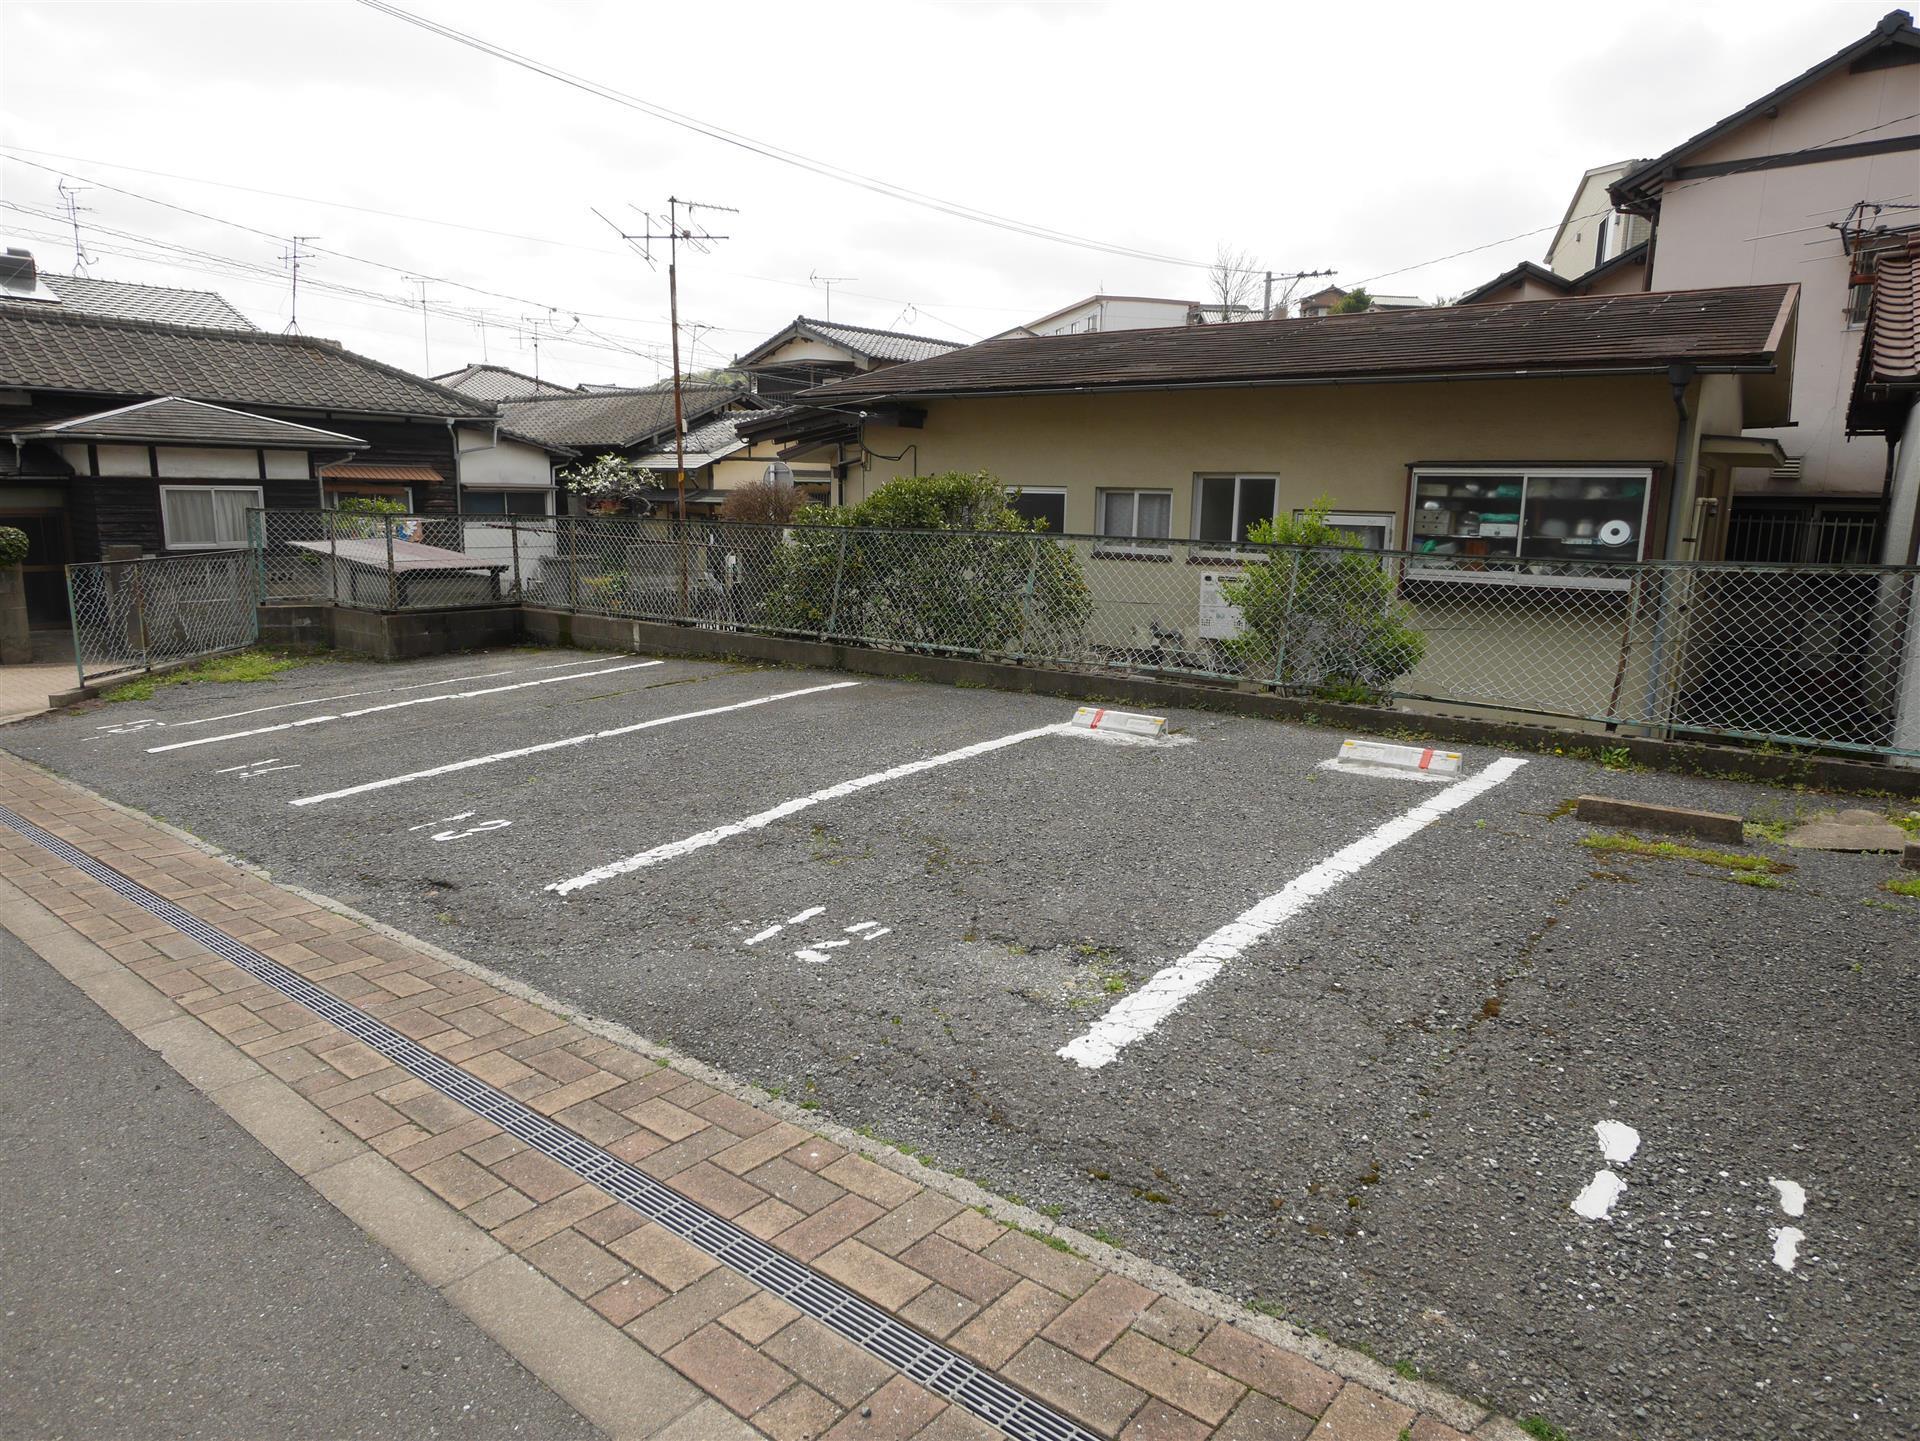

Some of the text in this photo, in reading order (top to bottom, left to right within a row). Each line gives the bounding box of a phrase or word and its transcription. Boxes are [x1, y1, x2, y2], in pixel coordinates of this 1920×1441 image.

[408, 810, 513, 842] 13
[743, 906, 892, 964] 12
[1570, 1119, 1808, 1275] 11
